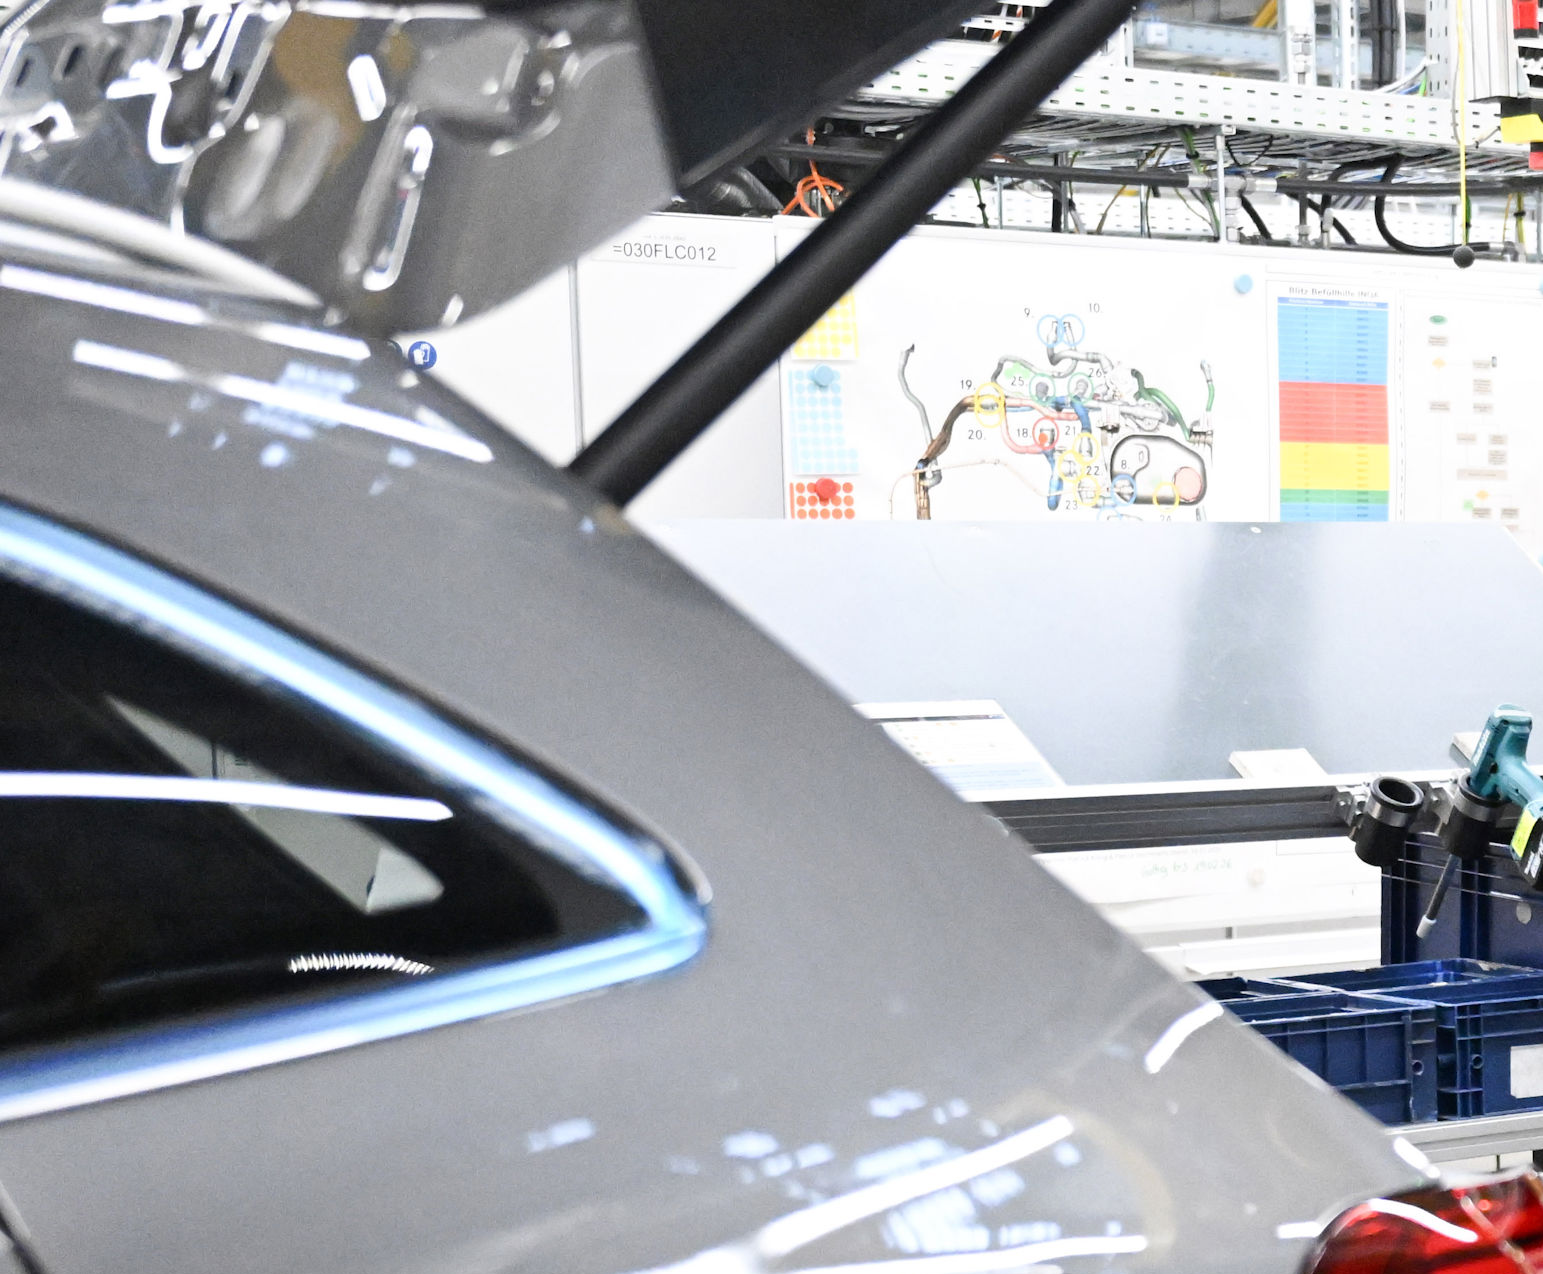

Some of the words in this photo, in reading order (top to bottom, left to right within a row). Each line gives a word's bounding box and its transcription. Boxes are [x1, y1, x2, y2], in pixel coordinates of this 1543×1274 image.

[612, 242, 717, 262] =030FLC012
[960, 380, 976, 391] 19.
[1010, 376, 1028, 387] 25.
[967, 429, 987, 441] 20.
[1016, 428, 1031, 439] 18.
